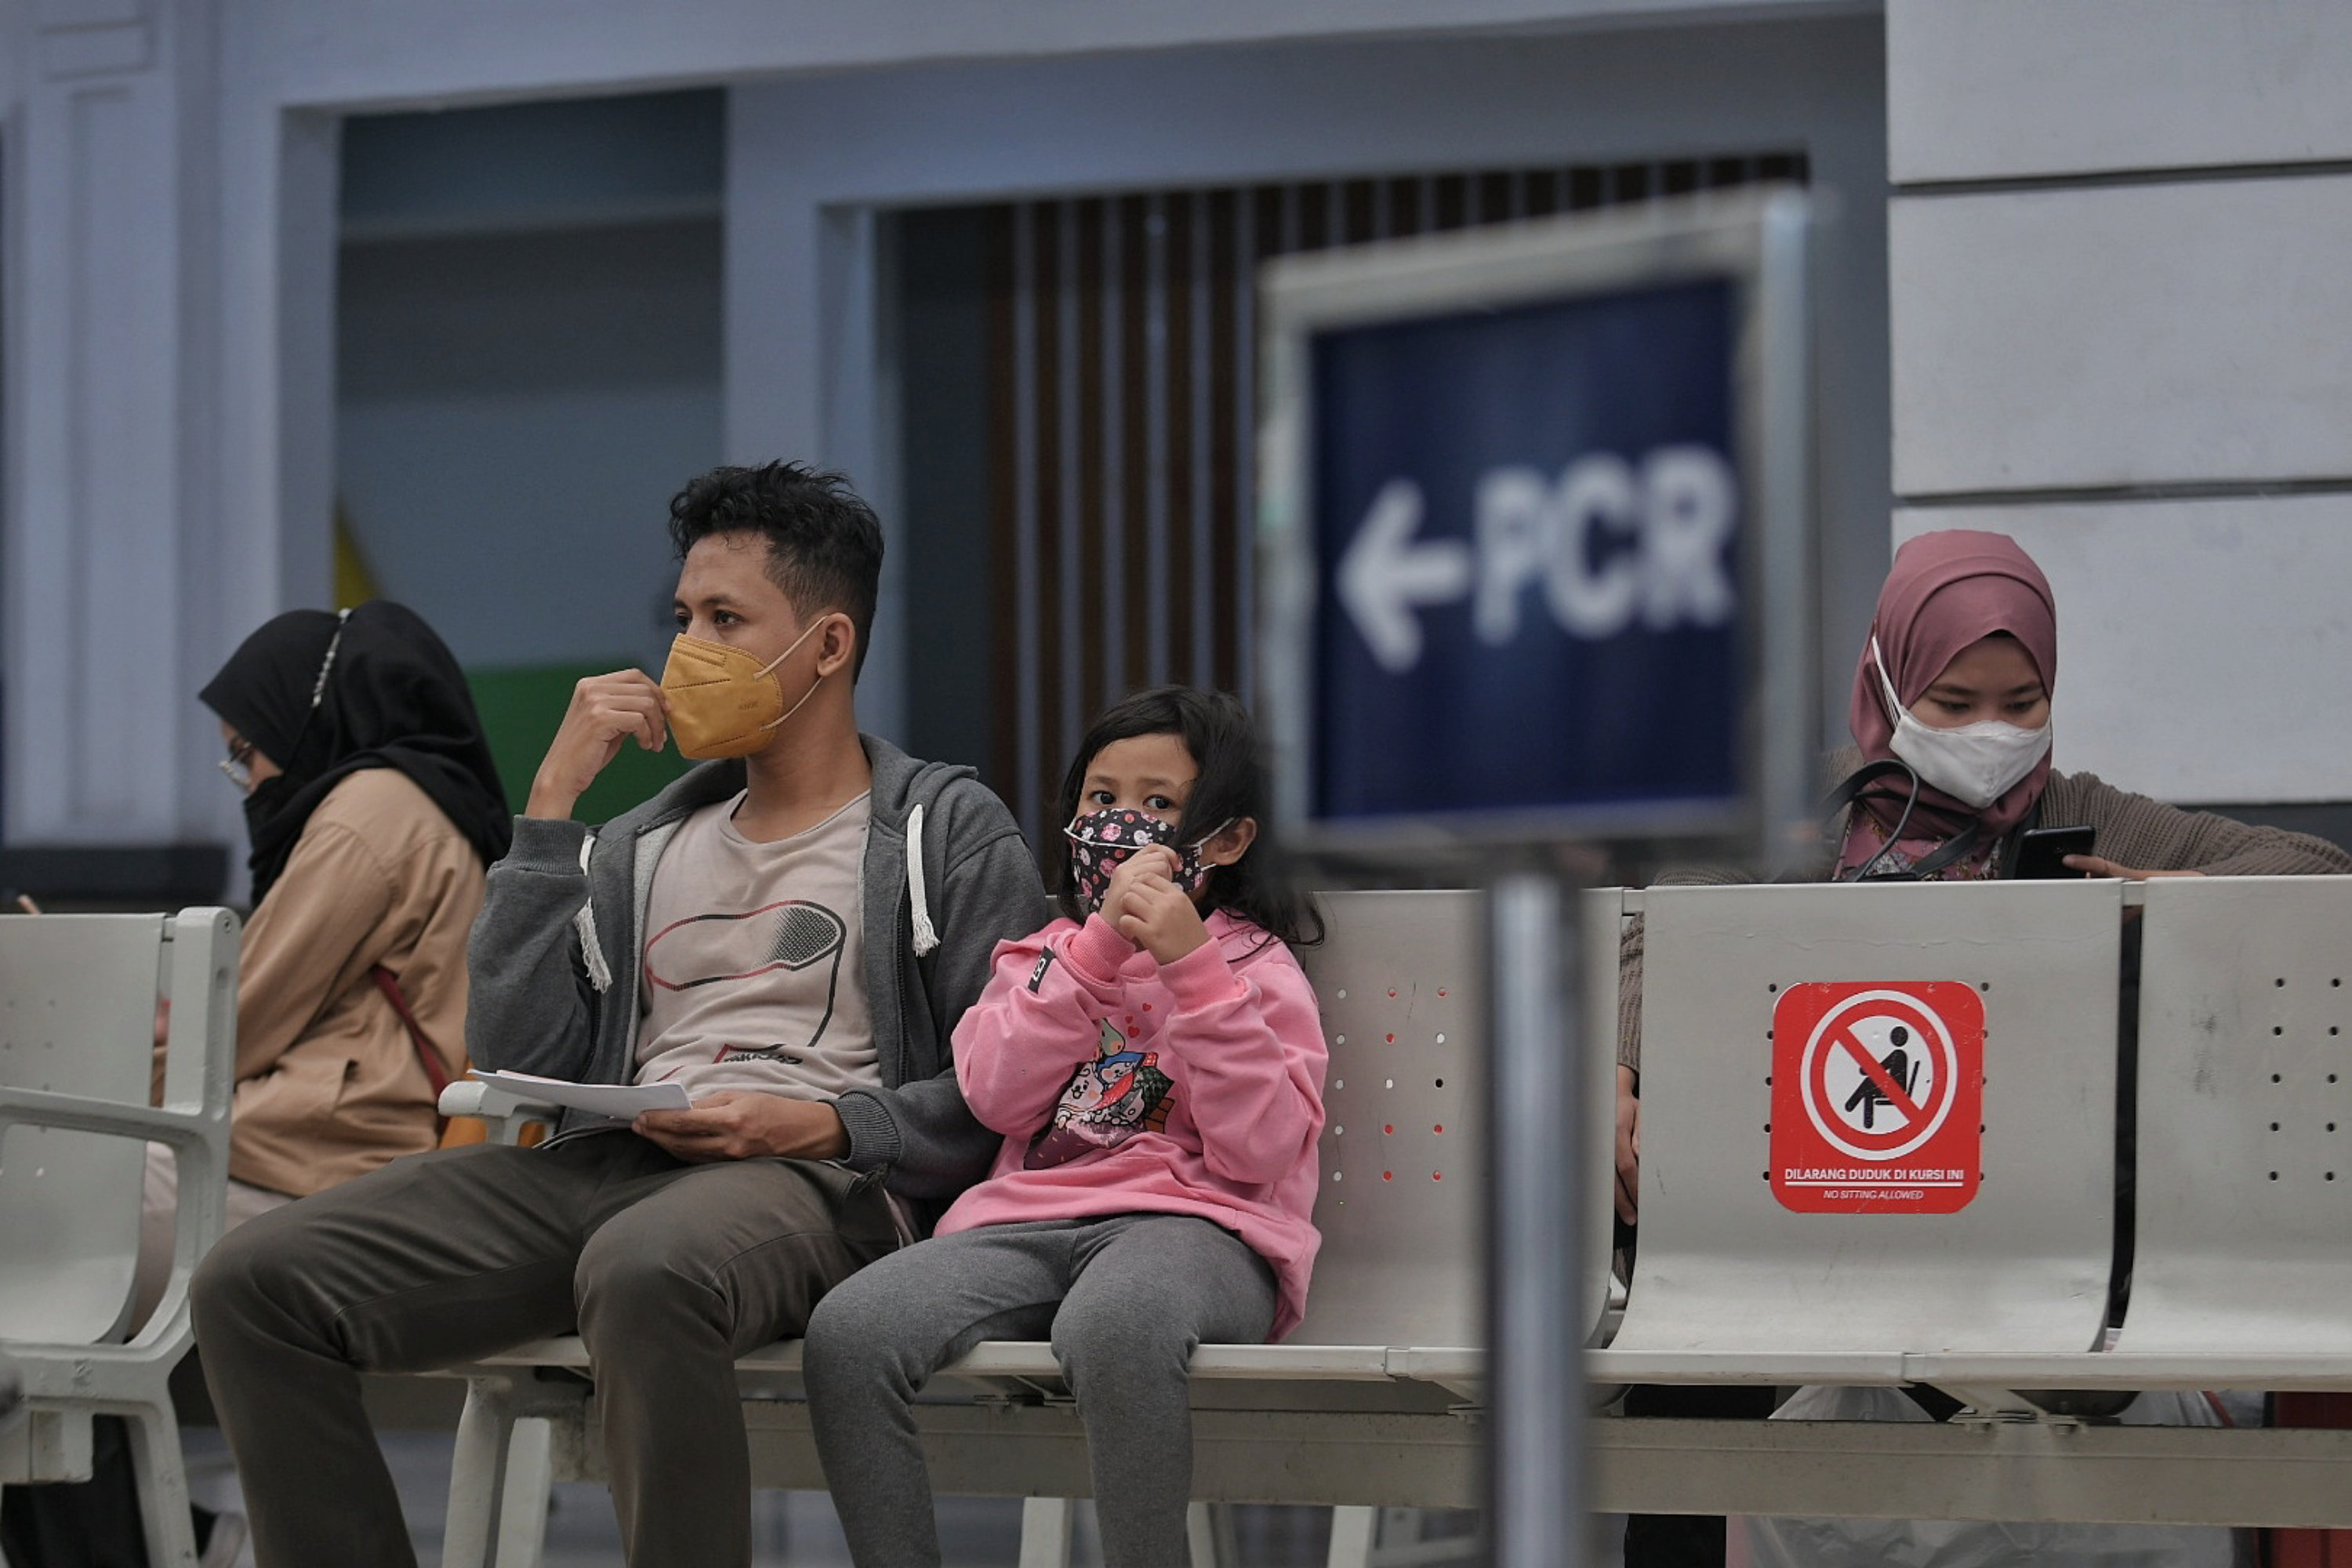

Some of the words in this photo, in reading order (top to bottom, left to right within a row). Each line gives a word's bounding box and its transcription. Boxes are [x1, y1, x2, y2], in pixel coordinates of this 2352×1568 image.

[1475, 447, 1737, 643] PCR
[1784, 1168, 1847, 1180] DILARANG
[1849, 1169, 1891, 1180] DUDUK
[1894, 1169, 1907, 1180] DI
[1908, 1169, 1945, 1180] KURSI
[1947, 1169, 1964, 1180] INI
[1823, 1190, 1838, 1199] NO
[1839, 1190, 1877, 1200] SITTING
[1878, 1190, 1924, 1200] ALLOWED
